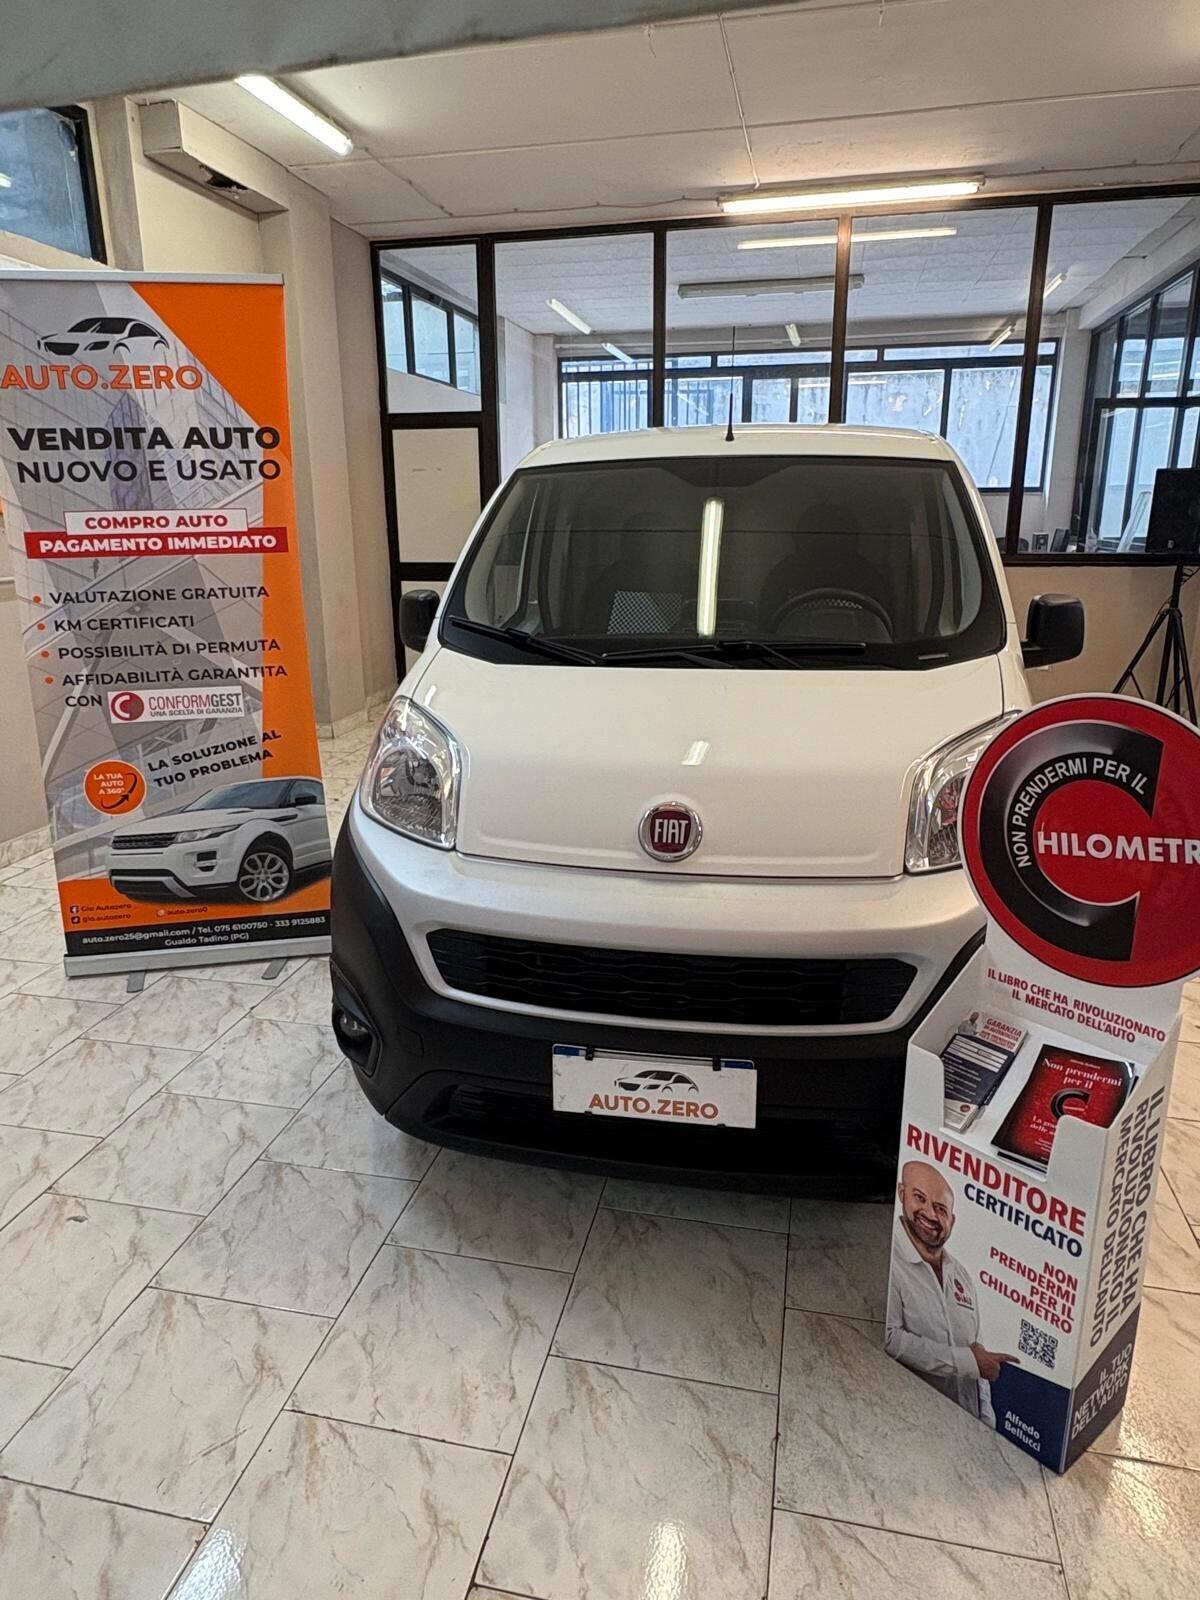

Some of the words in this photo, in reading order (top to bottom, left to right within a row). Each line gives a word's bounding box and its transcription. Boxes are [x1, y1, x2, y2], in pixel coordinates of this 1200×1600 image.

[1, 364, 203, 391] AUTO.ZERO
[7, 427, 173, 451] VENDITA
[183, 426, 281, 450] AUTO
[17, 460, 138, 483] NUOVO
[150, 460, 165, 481] E
[176, 459, 281, 481] USATO
[85, 515, 170, 530] COMPRO
[175, 514, 229, 528] AUTO
[39, 537, 163, 554] PAGAMENTO
[167, 534, 278, 552] IMMEDIATO
[49, 588, 177, 605] VALUTAZIONE
[181, 585, 270, 600] GRATUITA
[54, 618, 82, 632] KM
[87, 615, 195, 631] CERTIFICATI
[58, 641, 168, 659] POSSIBILITÀ
[173, 643, 192, 655] DI
[196, 638, 281, 654] PERMUTA
[62, 667, 183, 687] AFFIDABILITÀ
[188, 665, 288, 681] GARANTITA
[65, 695, 103, 707] CON
[148, 693, 242, 711] CONFORMGEST
[206, 707, 243, 715] GARANZIA
[147, 761, 169, 772] LA
[171, 735, 258, 766] SOLUZIONE
[262, 730, 281, 742] AL
[153, 771, 186, 787] TUO
[190, 749, 273, 779] PROBLEMA
[1092, 757, 1131, 783] PER
[1012, 757, 1088, 828] PRENDERMI
[1130, 773, 1149, 795] IL
[654, 818, 689, 845] FIAT
[1011, 830, 1032, 868] NON
[164, 938, 197, 946] Gualdo
[198, 935, 229, 943] Tadino
[230, 932, 249, 941] (PG)
[214, 924, 231, 933] 075
[232, 921, 268, 931] 6100750
[275, 920, 290, 928] 333
[987, 968, 997, 980] IL
[998, 972, 1028, 991] LIBRO
[1030, 984, 1051, 1000] CHE
[1053, 991, 1068, 1006] HA
[1073, 999, 1166, 1042] RIVOLUZIONATO
[1012, 989, 1022, 1000] IL
[1025, 994, 1075, 1020] MERCATO
[1077, 1014, 1136, 1043] DELL'AUTO
[986, 1018, 1022, 1037] GARANZIA
[1041, 1058, 1063, 1071] Non
[1065, 1067, 1122, 1087] prendermi
[1063, 1076, 1082, 1086] per
[588, 1093, 719, 1119] AUTO.ZERO
[1148, 1086, 1165, 1119] IL
[1106, 1112, 1134, 1228] MERCATO
[1135, 1117, 1160, 1207] LIBRO
[906, 1123, 1087, 1236] RIVENDITORE
[1109, 1097, 1150, 1302] RIVOLUZIONATO
[964, 1183, 1083, 1258] CERTIFICATO
[1127, 1210, 1147, 1270] CHE
[990, 1246, 1077, 1305] PRENDERMI
[1043, 1262, 1078, 1291] NON
[979, 1270, 1073, 1334] CHILOMETRO
[1030, 1284, 1057, 1311] PER
[1061, 1300, 1075, 1321] IL
[1120, 1267, 1139, 1315] HA
[1105, 1302, 1121, 1332] IL
[1100, 1368, 1108, 1384] IL
[1112, 1343, 1132, 1371] TUO
[1074, 1357, 1129, 1425] NETWORK
[1004, 1420, 1041, 1452] Bellucci
[1005, 1411, 1040, 1439] Alfredo
